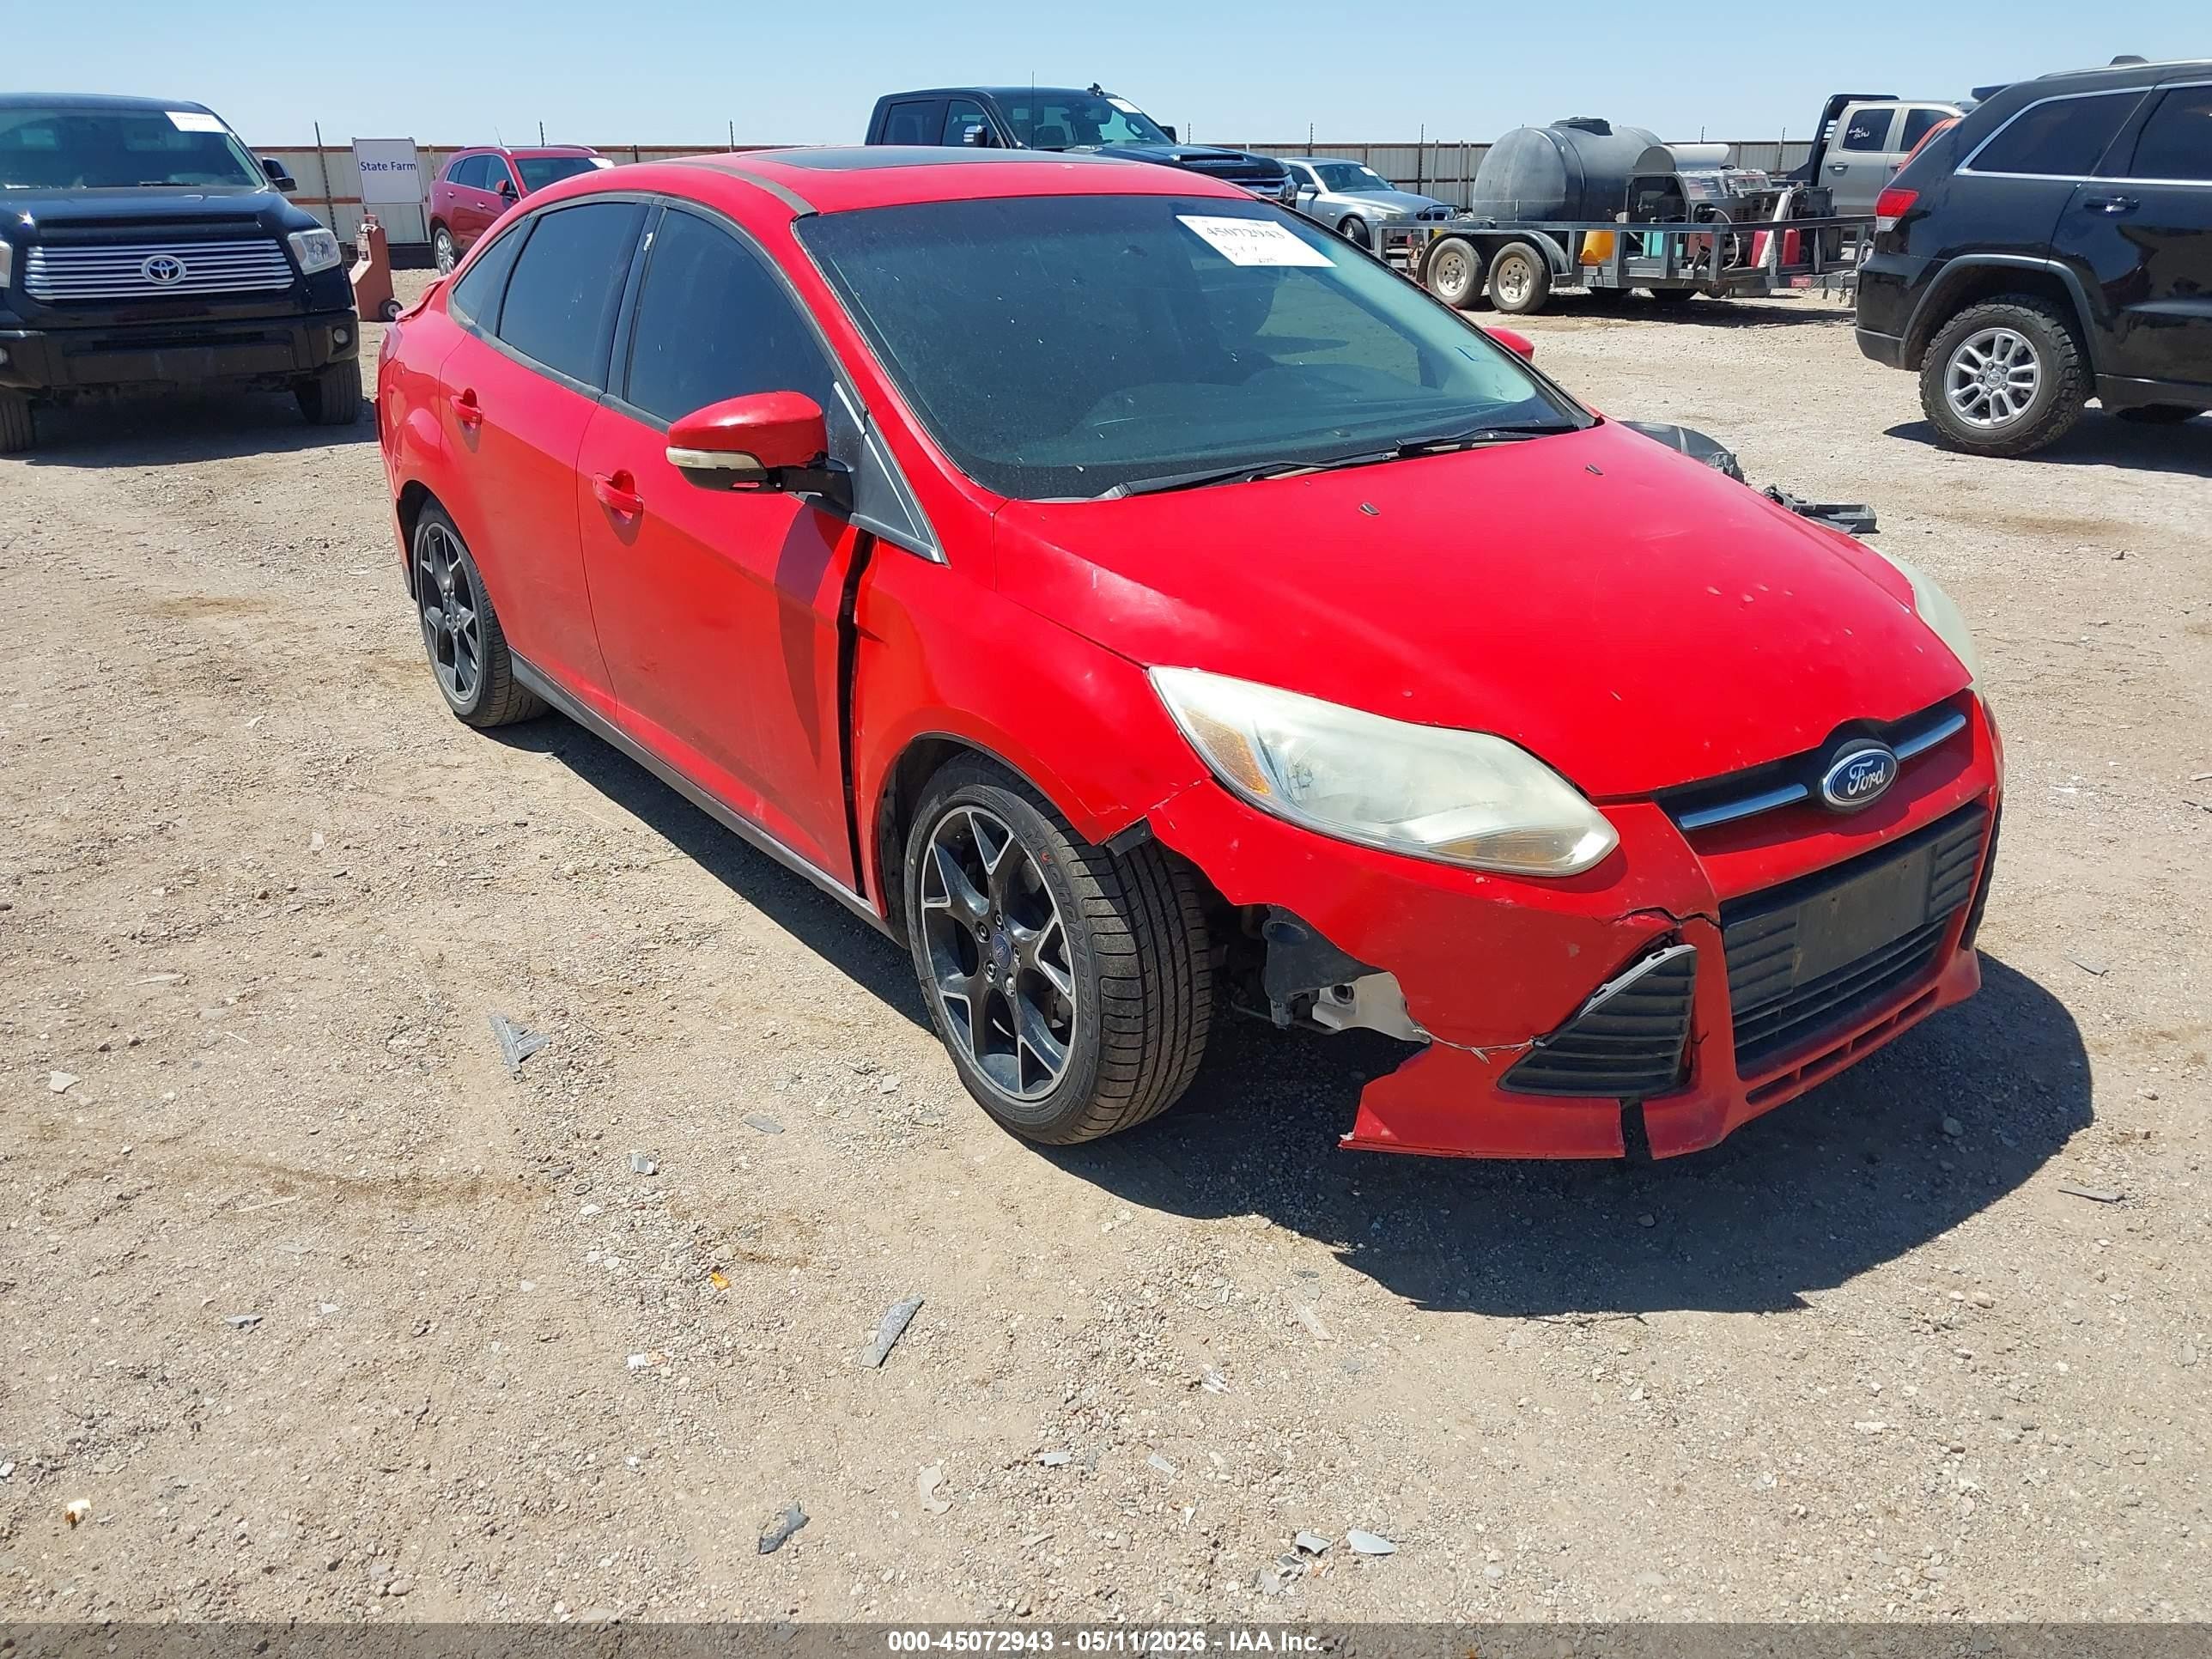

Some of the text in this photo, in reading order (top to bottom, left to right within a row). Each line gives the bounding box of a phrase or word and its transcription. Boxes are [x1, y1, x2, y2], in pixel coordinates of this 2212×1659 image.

[361, 161, 416, 172] State Farm
[1848, 760, 1886, 795] Ford
